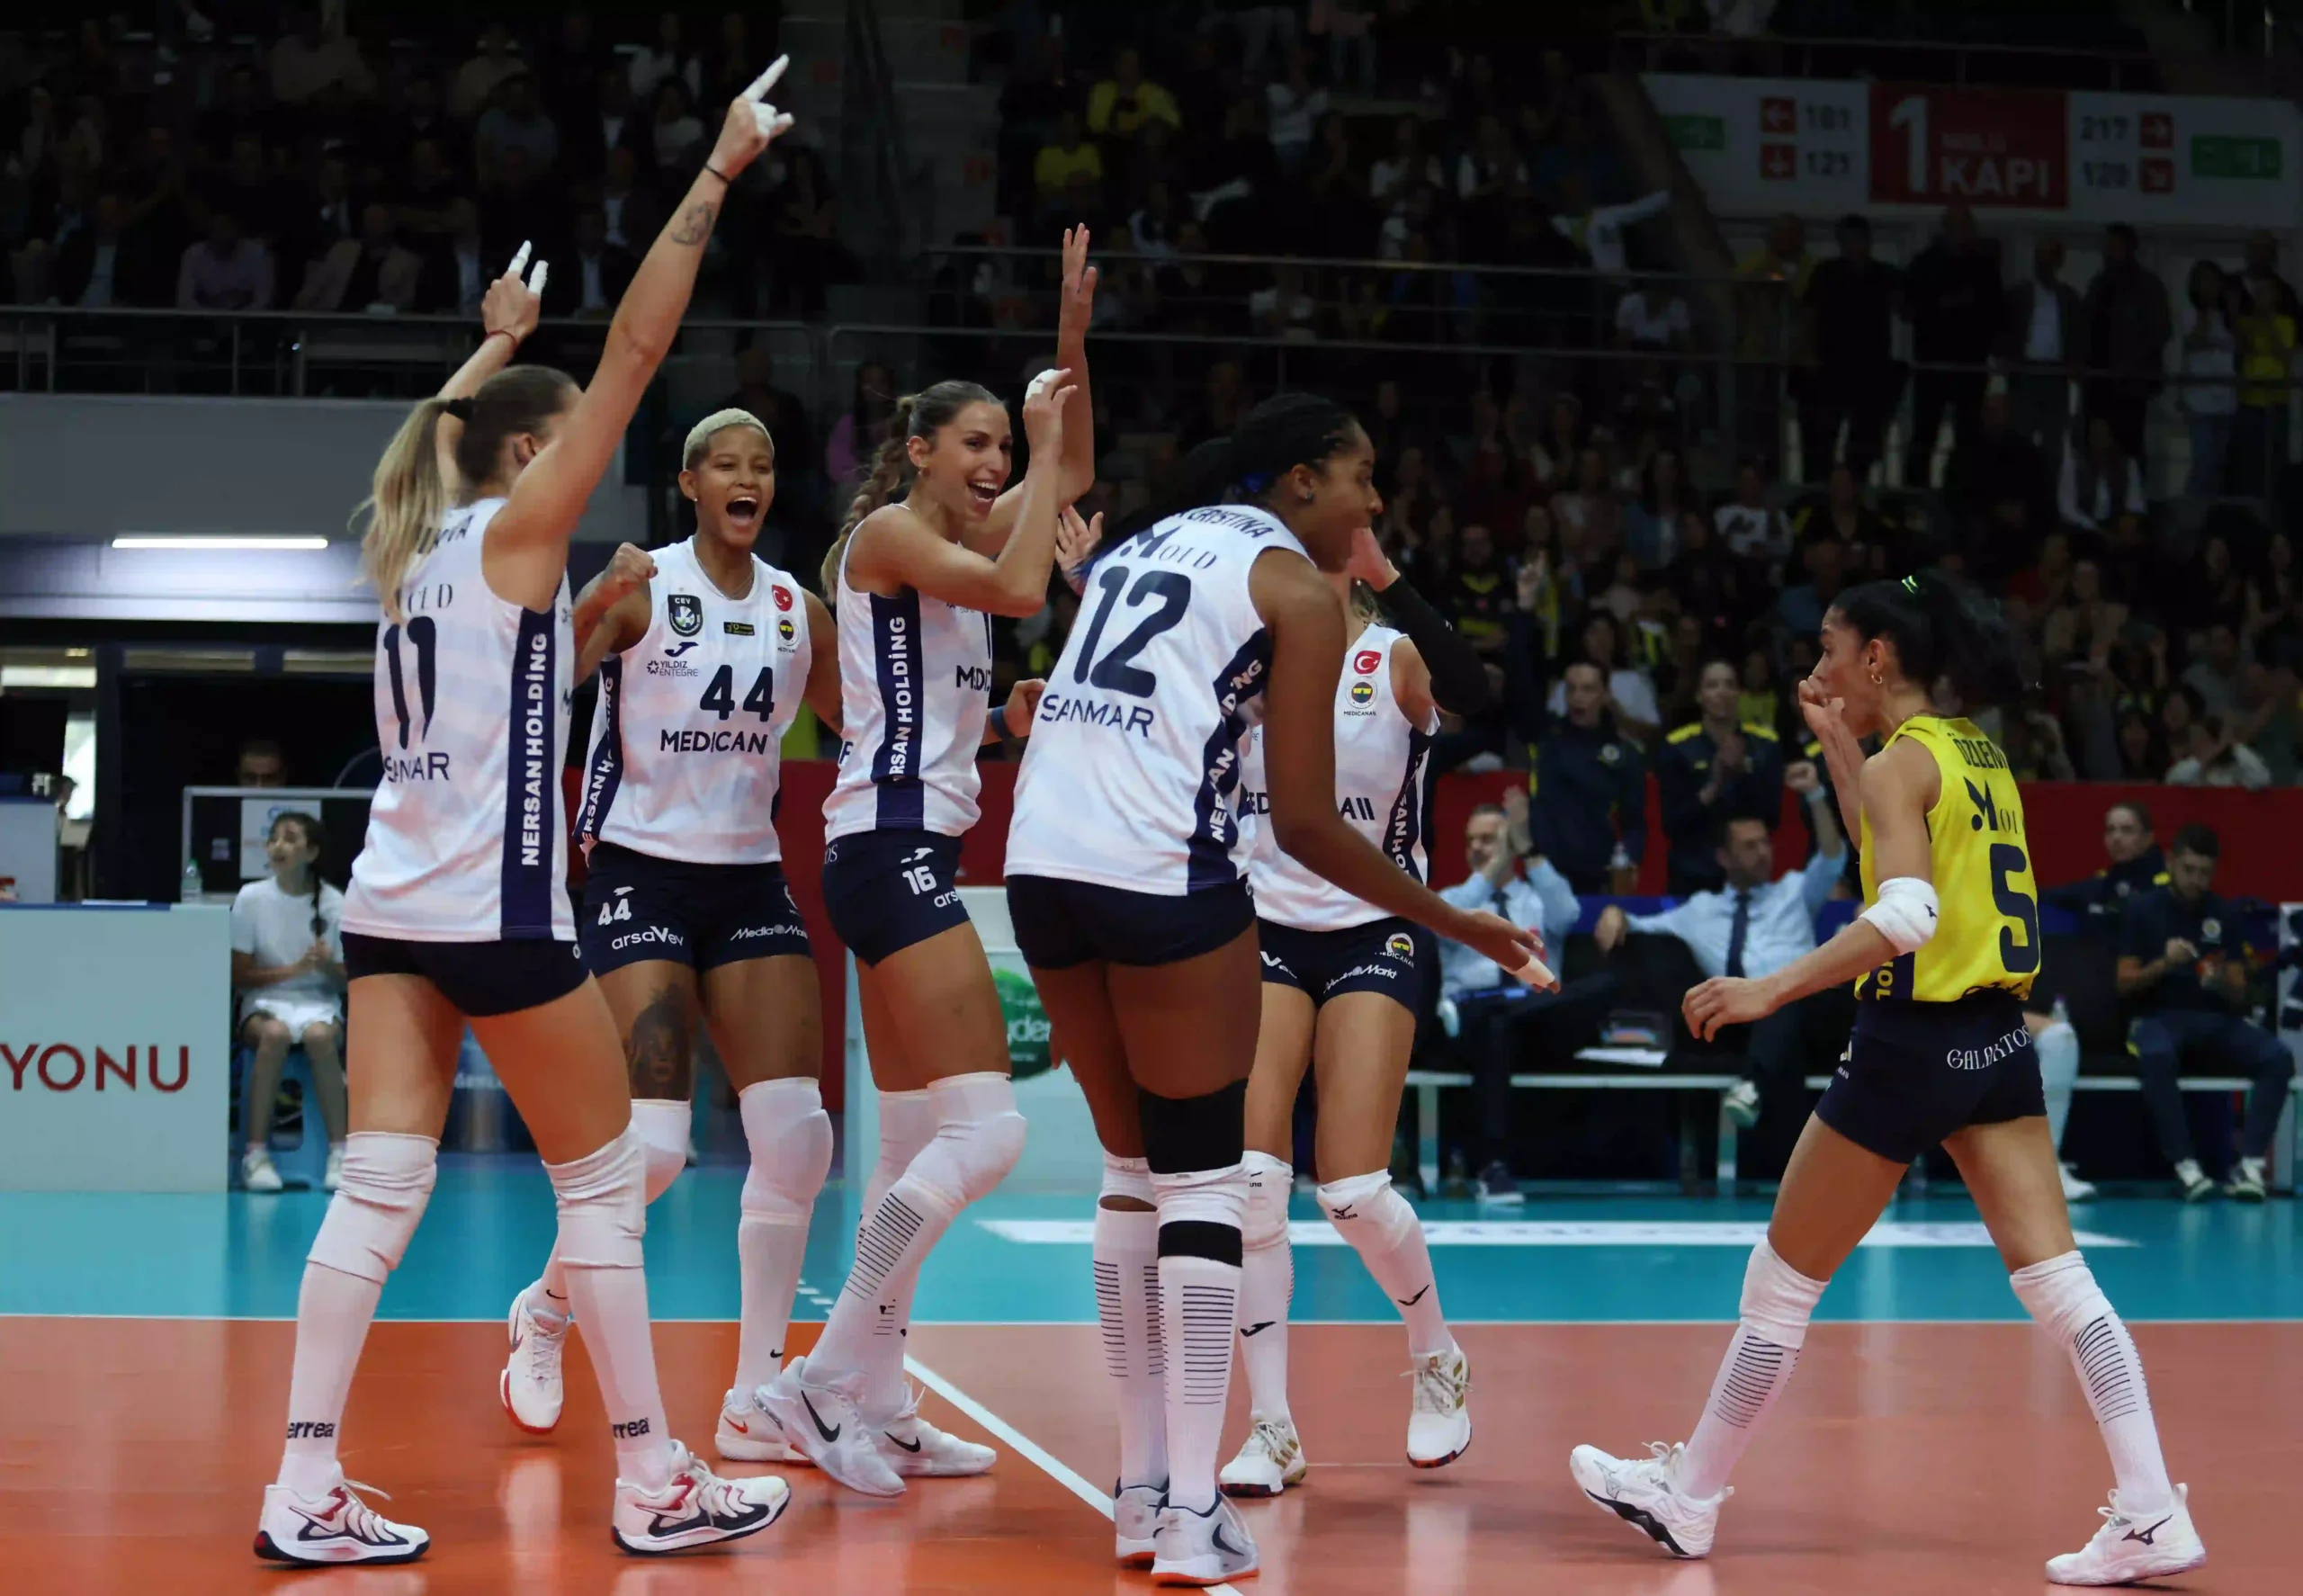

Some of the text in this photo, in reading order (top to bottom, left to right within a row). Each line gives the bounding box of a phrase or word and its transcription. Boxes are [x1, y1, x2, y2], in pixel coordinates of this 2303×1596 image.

[1888, 94, 1929, 195] 1
[1940, 156, 2050, 199] KAPI
[1073, 565, 1191, 699] 12
[699, 664, 775, 722] 44
[1040, 694, 1155, 739] SANMAR
[521, 757, 542, 866] NERSAN
[902, 865, 937, 896] 16
[597, 898, 632, 926] 44
[1989, 843, 2039, 973] 5
[0, 1043, 189, 1093] YONU
[286, 1420, 336, 1439] errea
